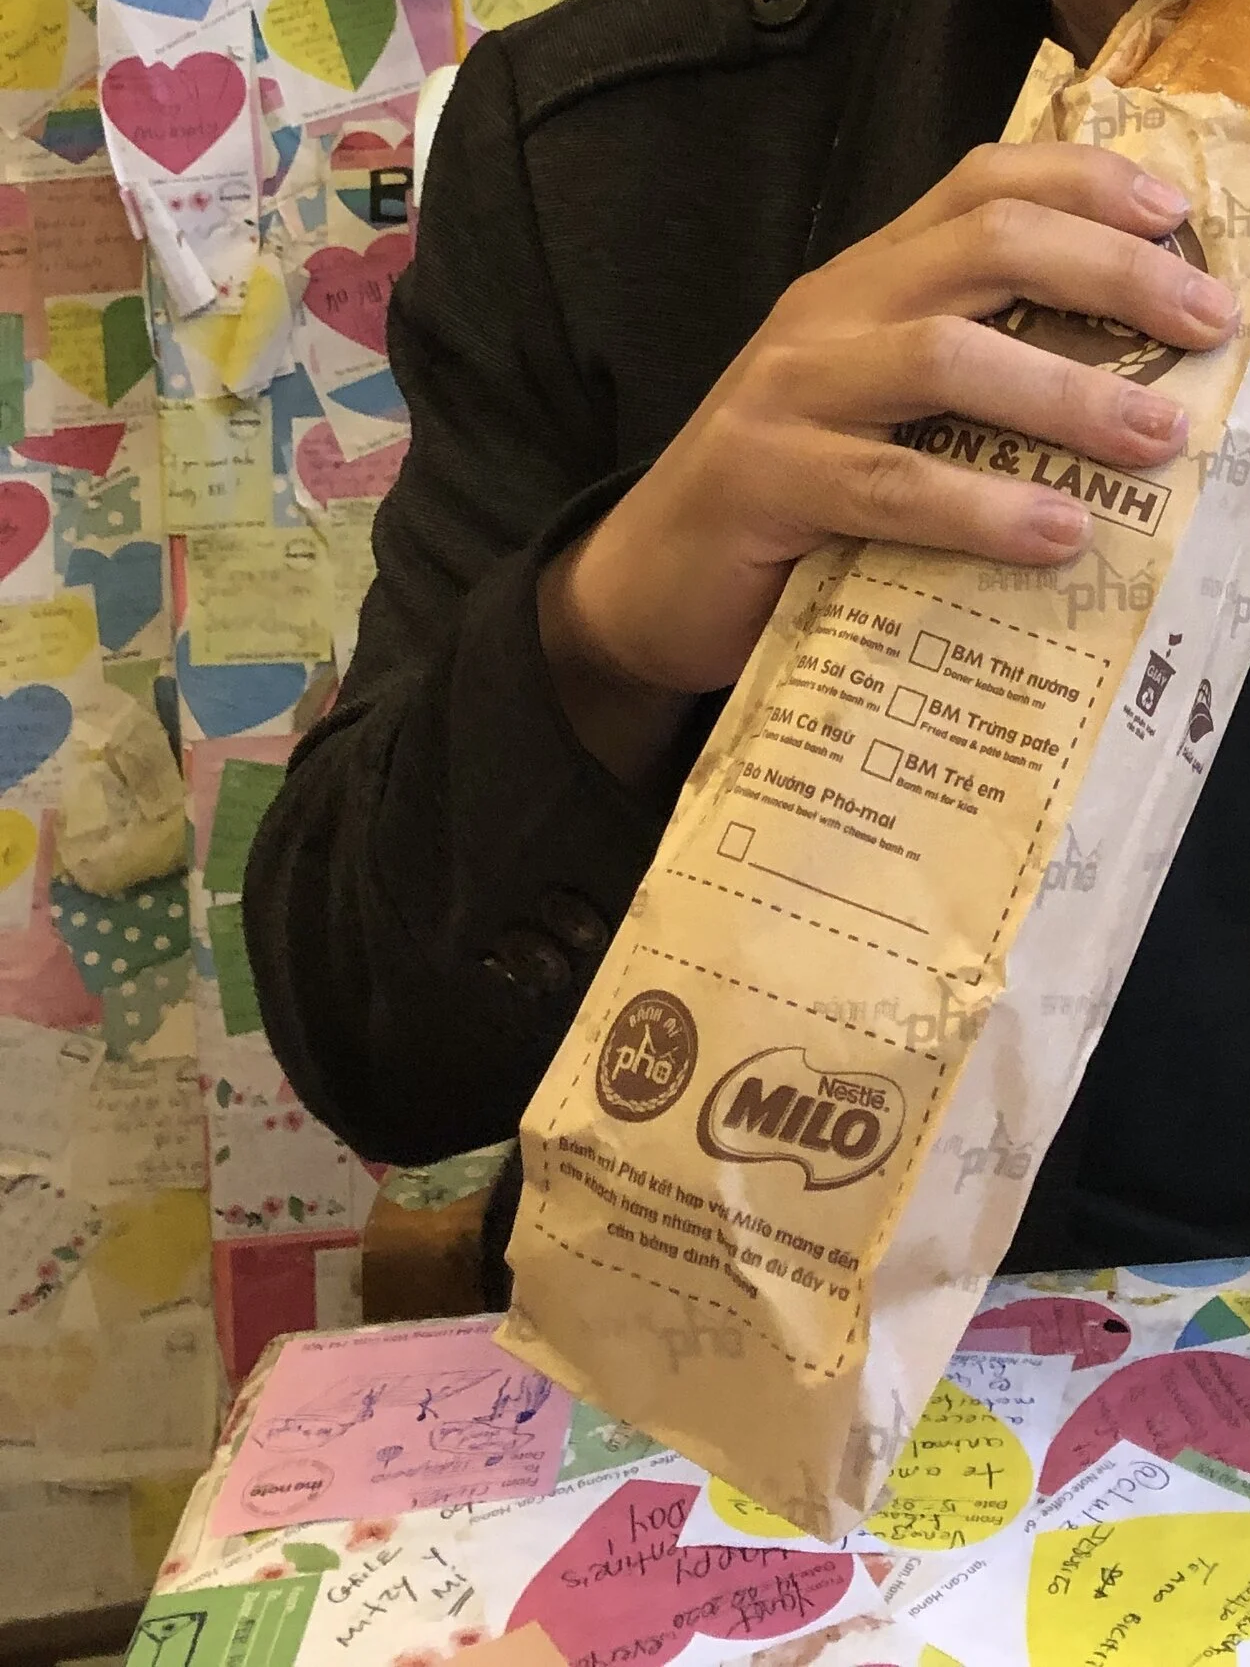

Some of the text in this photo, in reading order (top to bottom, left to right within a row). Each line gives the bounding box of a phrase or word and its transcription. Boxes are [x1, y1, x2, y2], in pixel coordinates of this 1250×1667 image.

[988, 438, 1020, 474] &
[796, 655, 819, 671] BM
[850, 669, 886, 694] Gòn
[943, 666, 1005, 697] Doner kebab
[950, 644, 1081, 703] BM Thịt nướng
[817, 683, 839, 698] style
[770, 706, 794, 725] BM
[928, 699, 961, 723] BM
[967, 711, 1019, 744] Trứng
[919, 720, 978, 750] Fried egg &
[763, 768, 816, 799] Nướng
[905, 753, 1006, 803] BM Trẻ em
[761, 793, 877, 845] minced beef with cheese
[940, 793, 979, 816] for kids
[613, 1024, 679, 1084] phố
[723, 1077, 880, 1160] MILO
[618, 1161, 648, 1187] Phố
[732, 1211, 772, 1238] Milo
[775, 1229, 825, 1259] mang
[913, 1438, 1003, 1458] animal
[1077, 1469, 1098, 1491] Note
[974, 1499, 1007, 1509] Date
[1044, 1486, 1076, 1514] Coffee
[966, 1515, 1003, 1526] From
[908, 1589, 943, 1620] Hanoi
